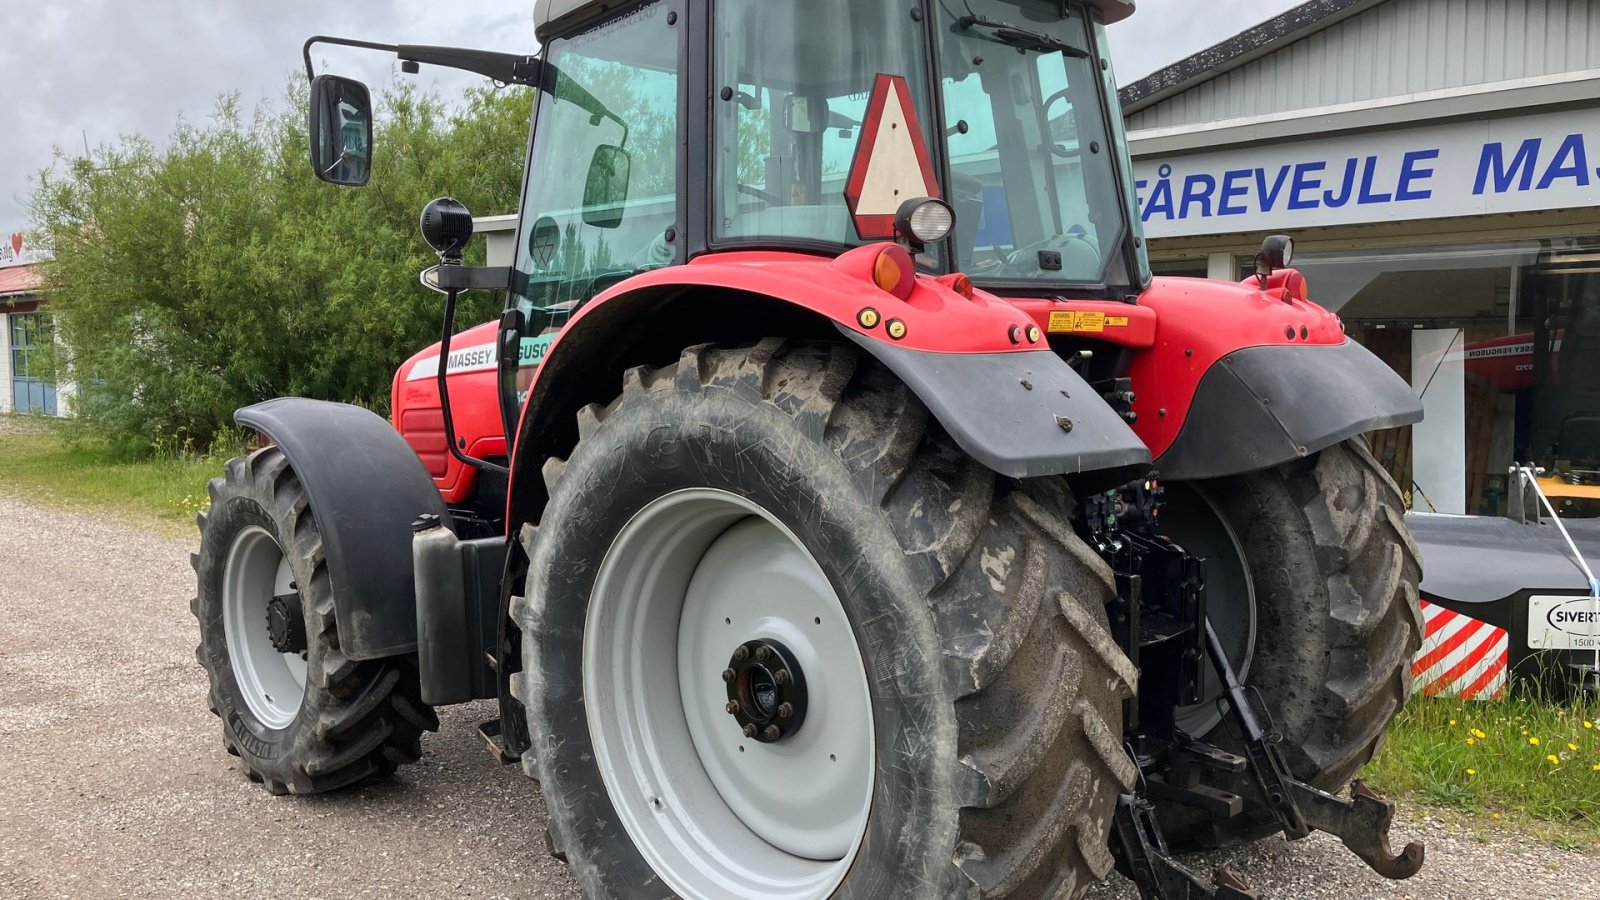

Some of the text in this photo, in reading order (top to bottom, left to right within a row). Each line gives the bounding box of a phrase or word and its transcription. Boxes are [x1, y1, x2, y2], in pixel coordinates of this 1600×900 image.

[1472, 133, 1600, 196] MA
[448, 349, 492, 369] MASSEY
[1573, 639, 1595, 647] 1500
